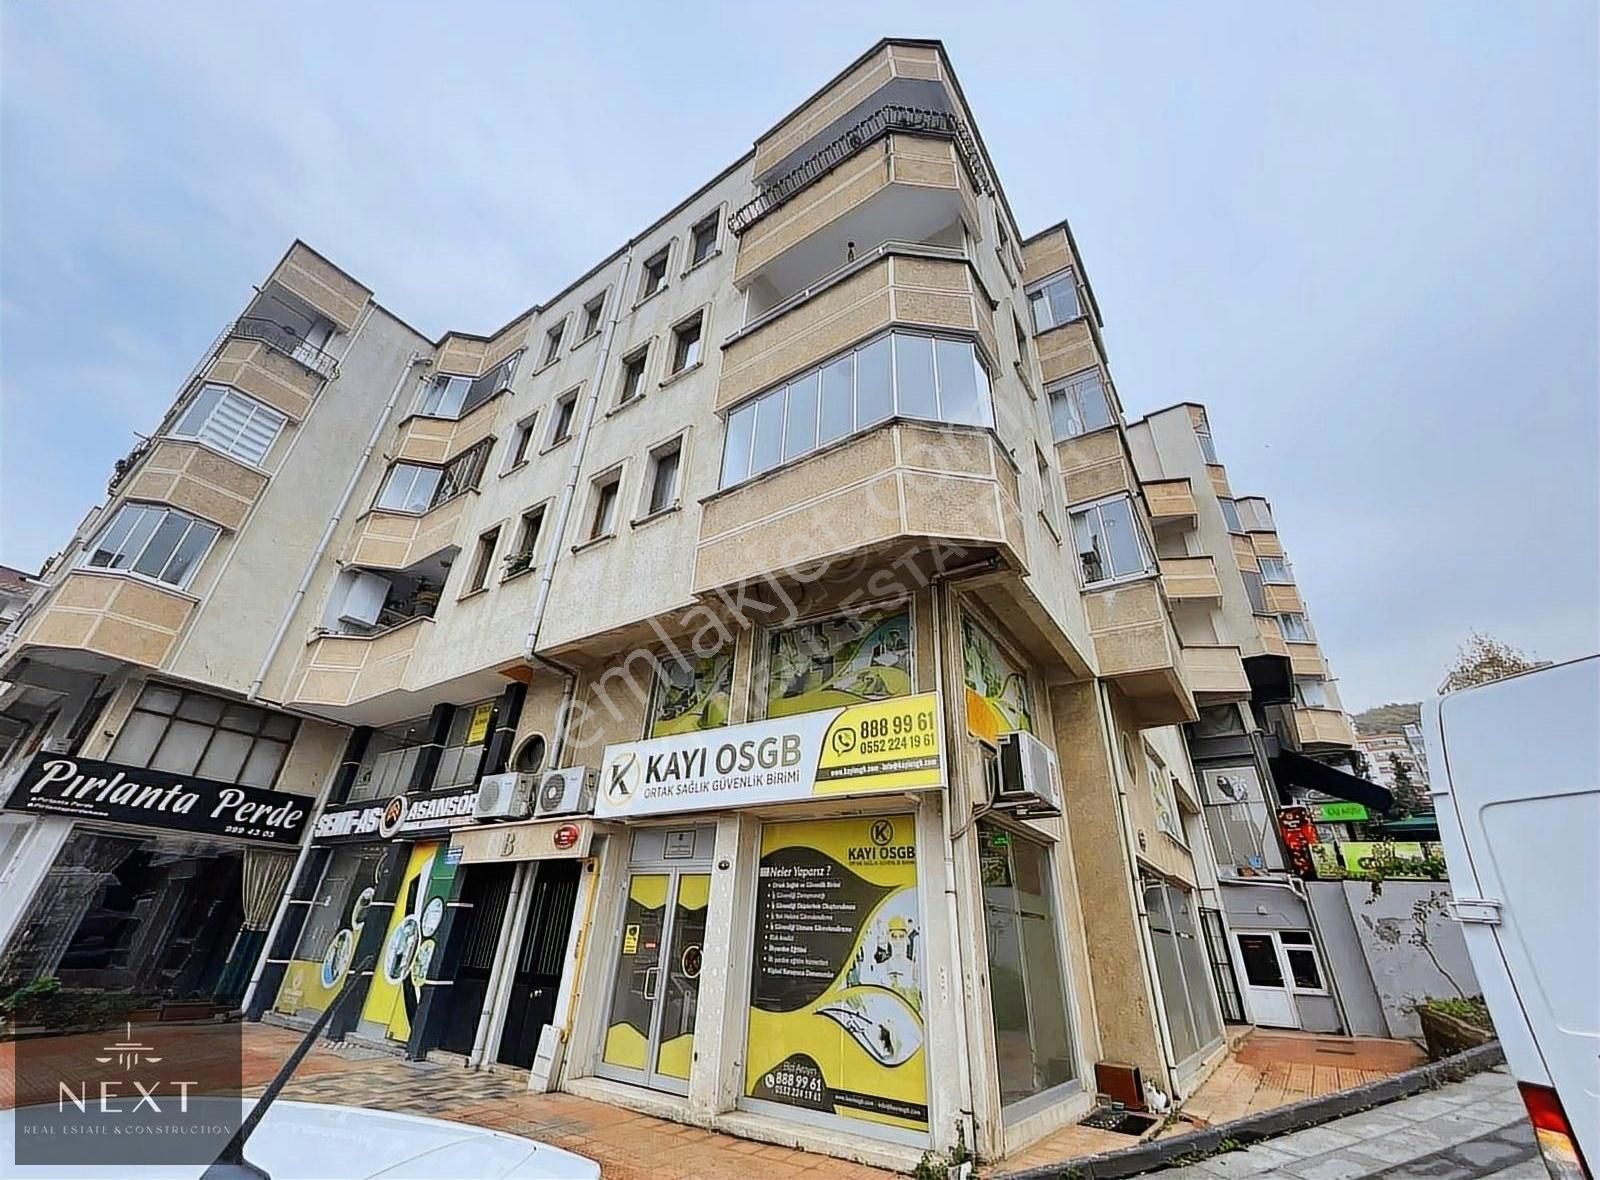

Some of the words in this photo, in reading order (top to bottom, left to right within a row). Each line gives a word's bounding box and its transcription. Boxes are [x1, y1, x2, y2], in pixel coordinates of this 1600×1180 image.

[860, 717, 888, 739] 888
[892, 714, 913, 735] 99
[917, 711, 934, 732] 61
[860, 740, 886, 754] 0552
[888, 738, 907, 751] 224
[910, 734, 921, 748] 19
[923, 733, 935, 746] 61
[645, 748, 708, 784] KAYI
[715, 734, 801, 775] OSGB
[30, 760, 201, 814] Pırlanta
[210, 788, 304, 829] Perde
[643, 785, 674, 799] ORTAK
[675, 781, 710, 796] SAĞLIK
[712, 772, 766, 792] GÜVENLİK
[766, 769, 800, 786] BİRİMİ
[500, 832, 516, 857] B
[848, 847, 876, 861] KAYI
[880, 846, 916, 860] OSGB
[776, 1072, 794, 1086] 888
[796, 1075, 808, 1089] 99
[810, 1078, 821, 1091] 61
